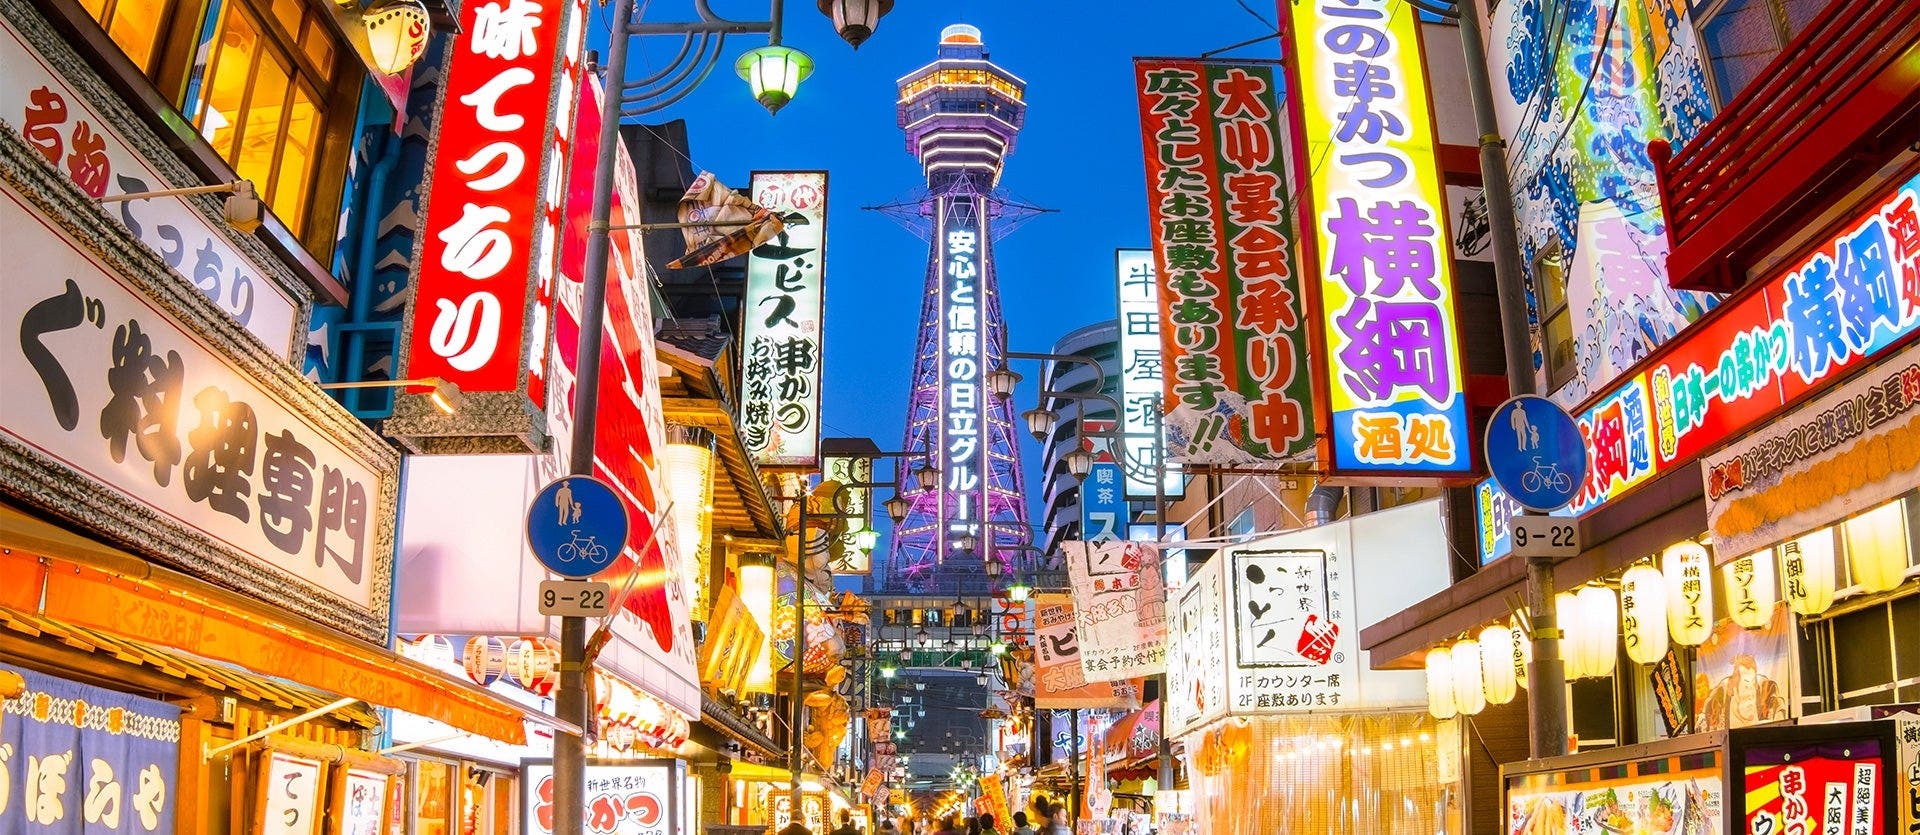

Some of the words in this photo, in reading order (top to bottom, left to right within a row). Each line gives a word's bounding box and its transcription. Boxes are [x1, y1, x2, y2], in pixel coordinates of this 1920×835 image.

[1320, 0, 1409, 189] 一の串かつ
[24, 85, 110, 199] 名物
[1327, 197, 1450, 403] 横綱
[1788, 221, 1899, 375] 横綱
[745, 336, 773, 448] お好み焼き
[774, 336, 817, 432] 串かつ
[1674, 325, 1788, 434] 日本一の串かつ
[20, 279, 366, 585] ぐ料理専門
[1358, 416, 1453, 461] 酒処
[1096, 470, 1115, 504] 喫茶
[1515, 526, 1576, 547] 9-22
[543, 590, 604, 609] 9-22
[1623, 595, 1639, 648] 串かつ
[1682, 565, 1703, 629] 横綱ソース
[1239, 676, 1252, 689] 1F
[1257, 674, 1341, 689] カウンター席
[1239, 694, 1253, 707] 2F
[1257, 692, 1342, 708] 座敷あります
[0, 743, 165, 831] ぼらや
[587, 776, 646, 793] 新世界名物
[1783, 770, 1806, 835] 串かつ
